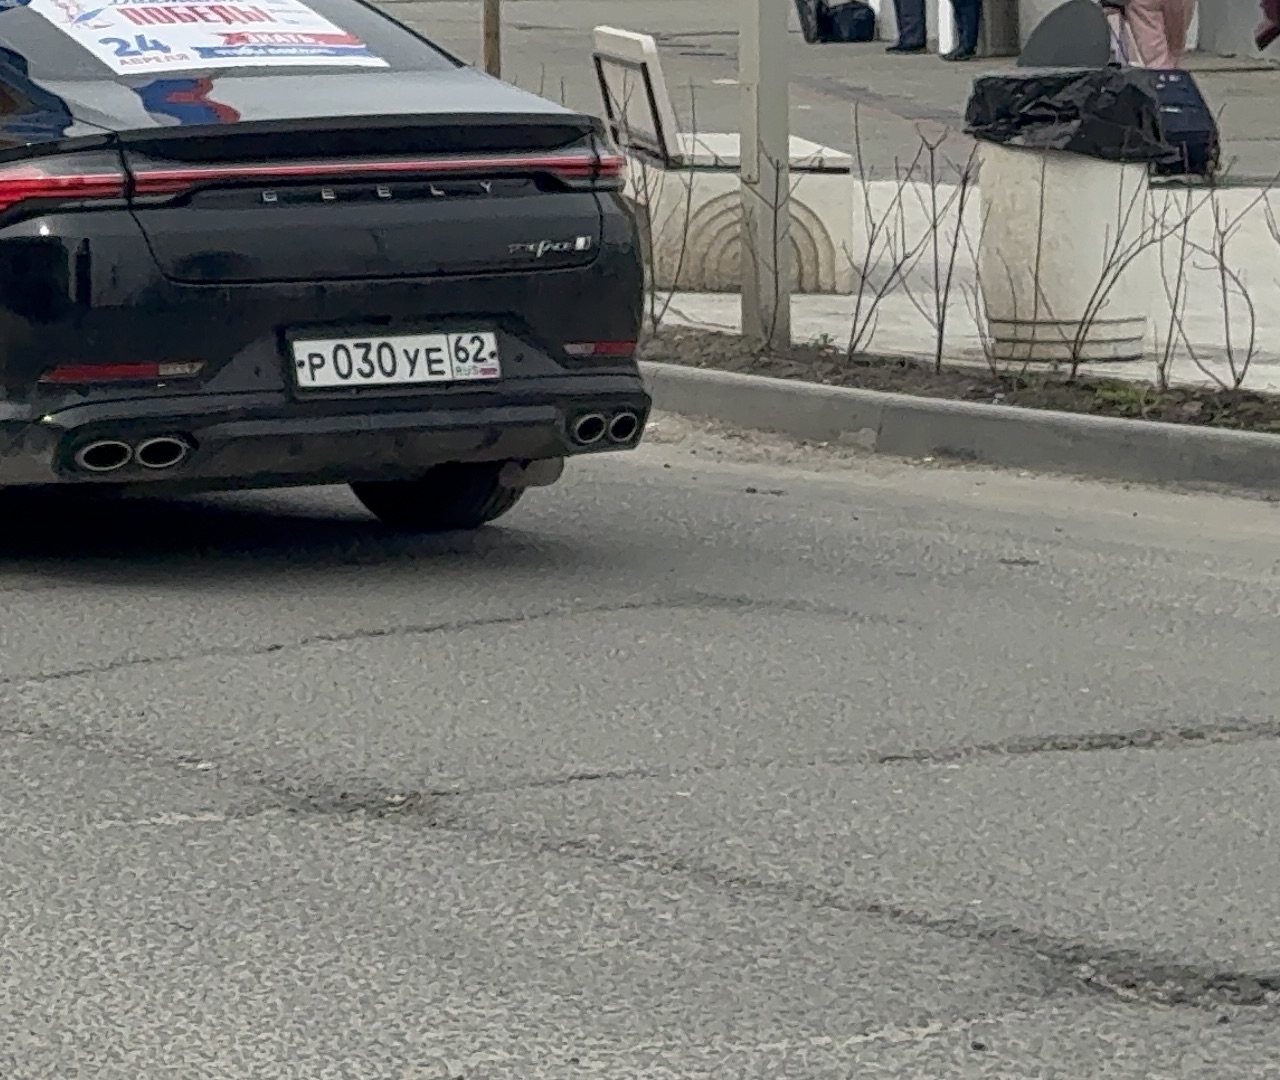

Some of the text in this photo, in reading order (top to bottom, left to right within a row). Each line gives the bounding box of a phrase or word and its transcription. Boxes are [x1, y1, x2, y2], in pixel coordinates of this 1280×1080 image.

[116, 5, 279, 25] ПОБЕДЫ
[98, 34, 172, 57] 24
[119, 53, 191, 66] АПРЕЛЯ
[454, 335, 487, 363] 62
